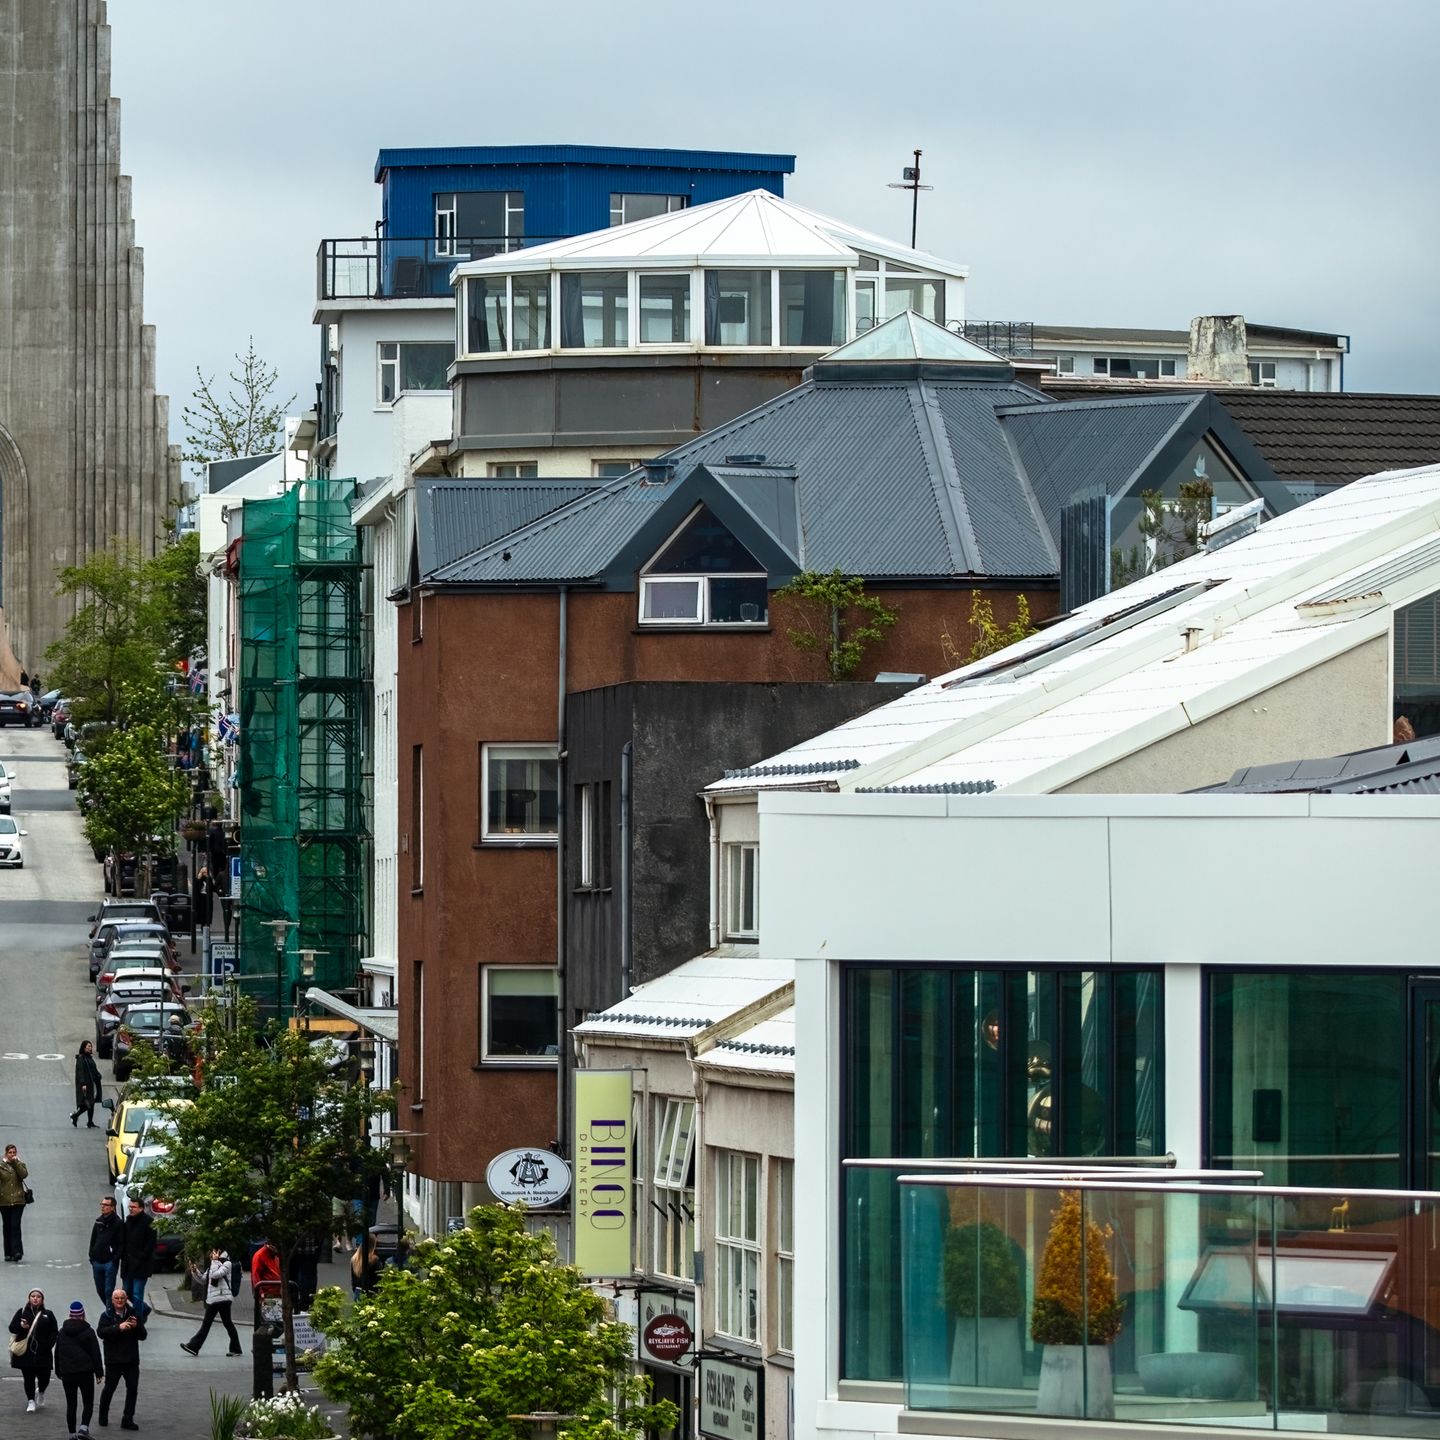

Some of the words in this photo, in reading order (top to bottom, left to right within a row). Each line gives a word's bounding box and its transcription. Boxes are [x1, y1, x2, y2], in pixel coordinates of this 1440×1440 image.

[1, 1052, 66, 1061] 30
[591, 1120, 625, 1229] BINGO
[707, 1369, 716, 1406] FISH
[722, 1373, 735, 1413] CHIPS
